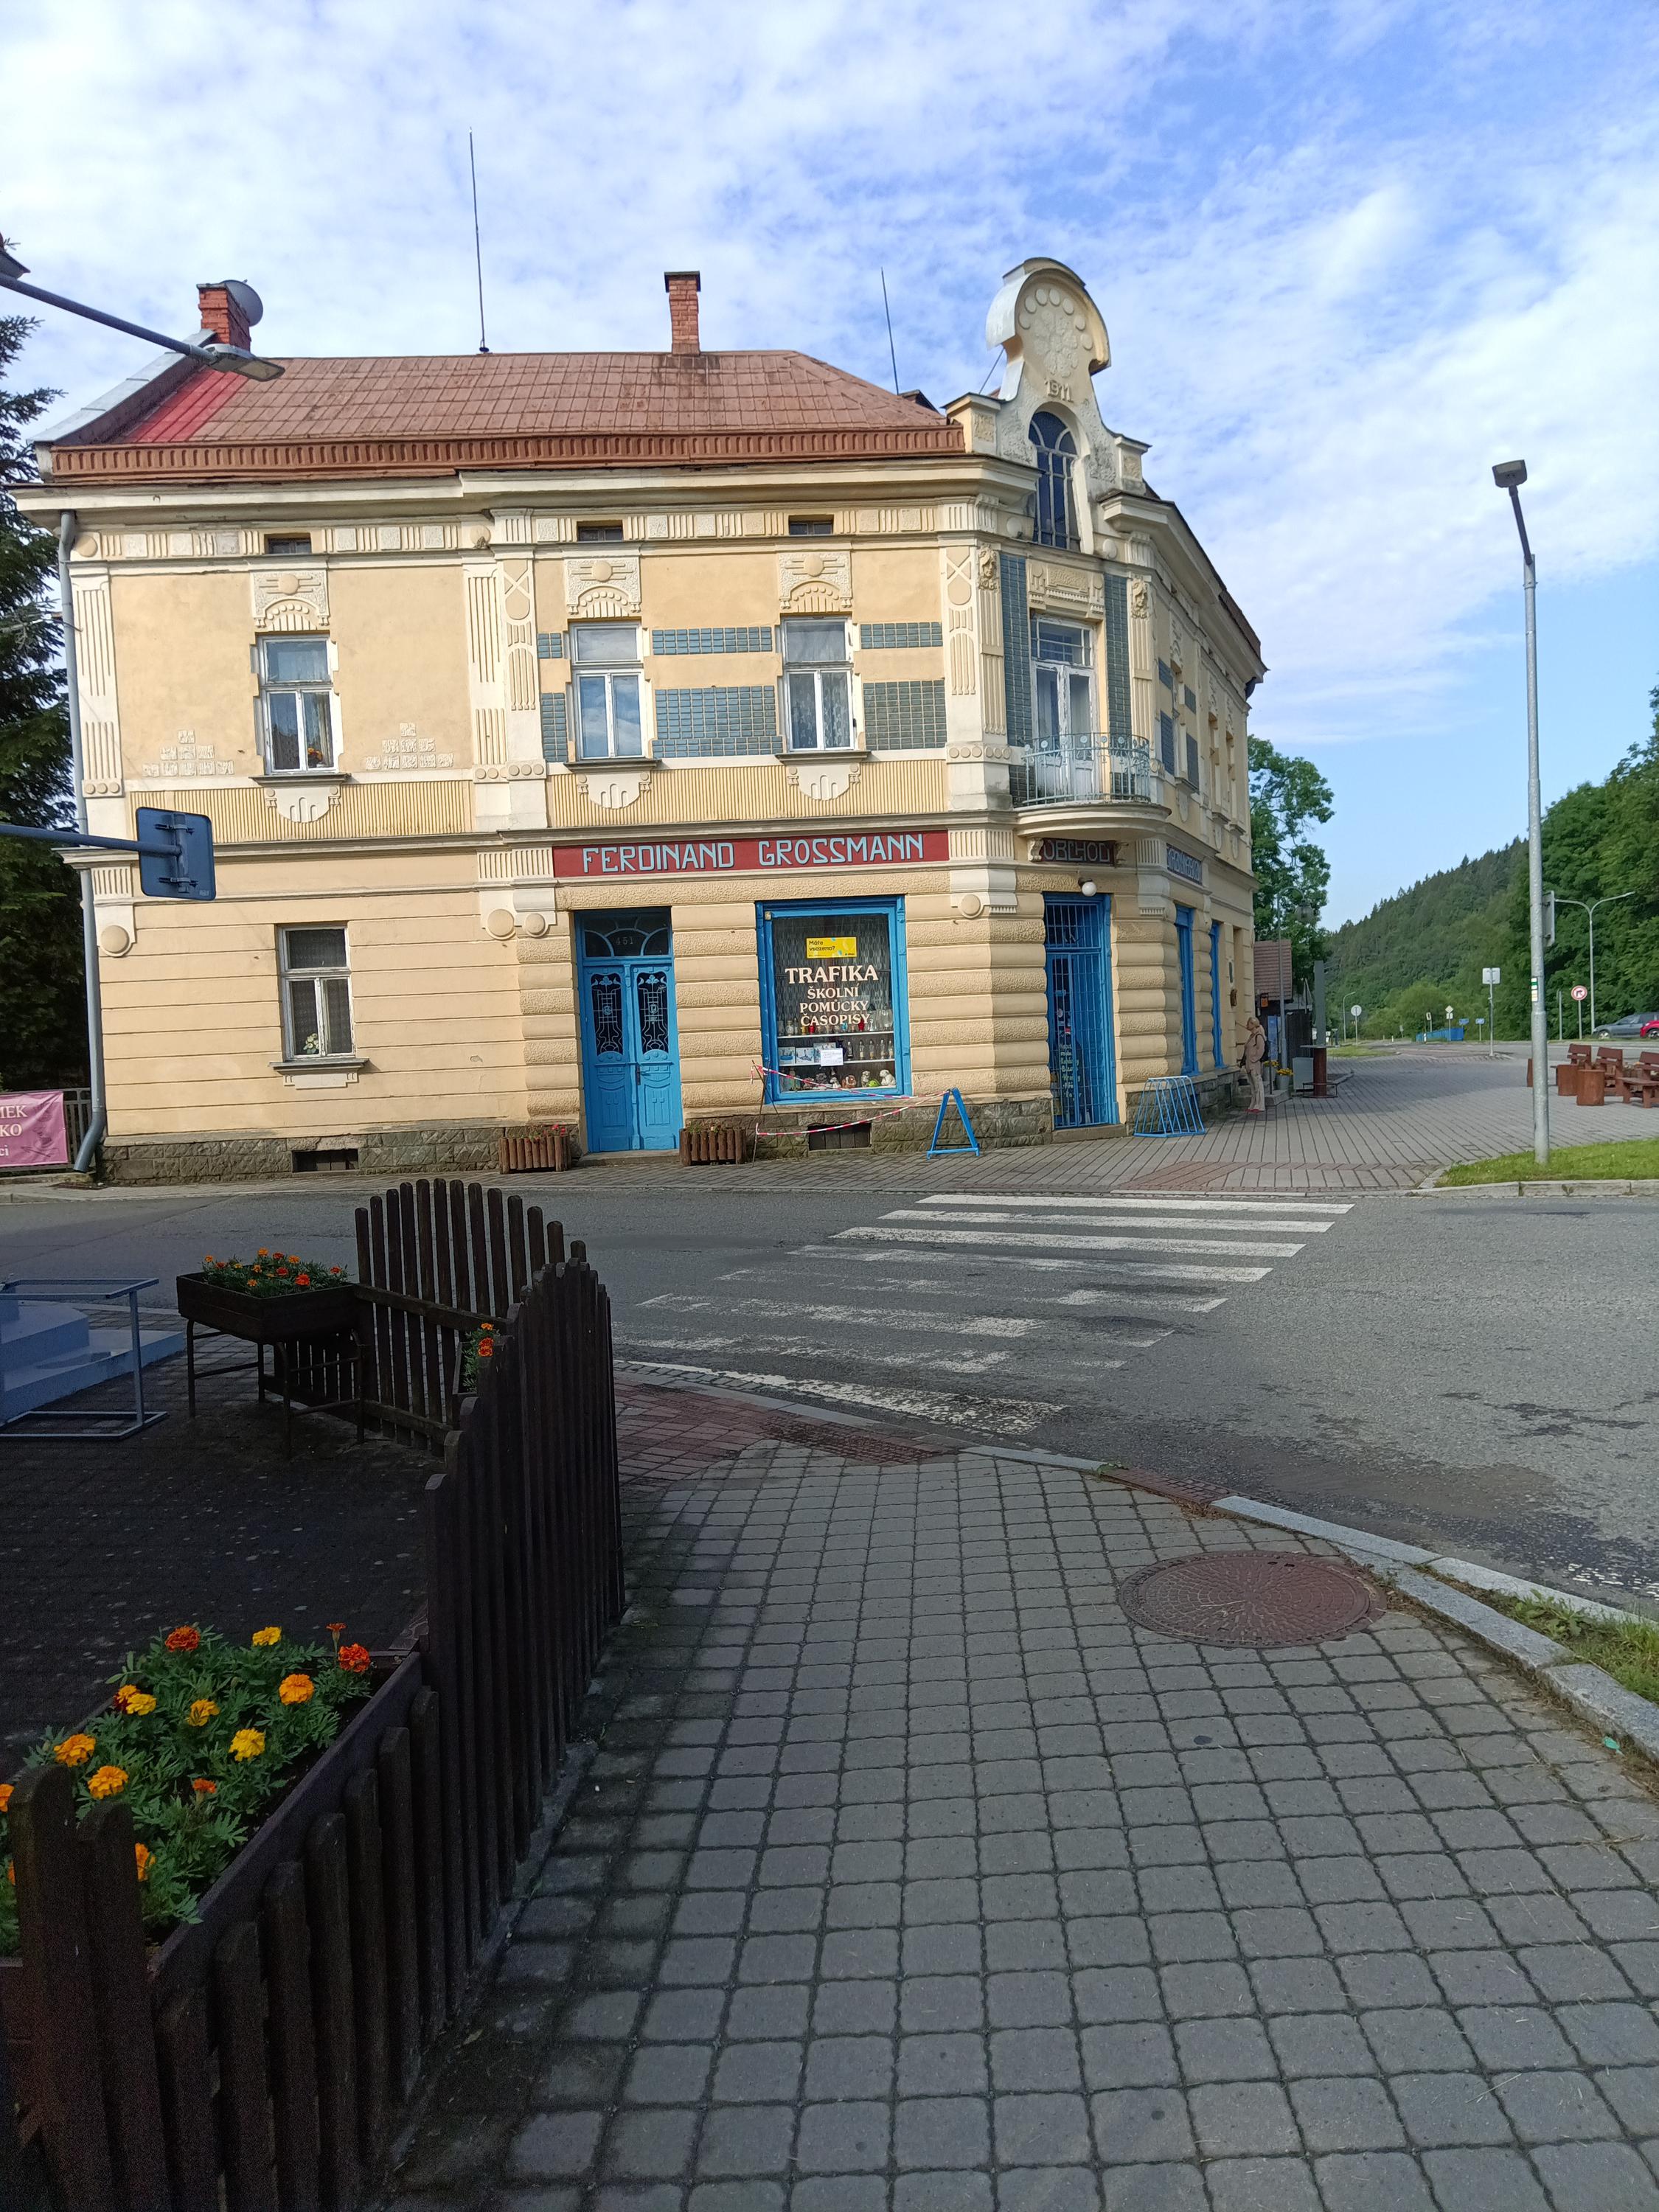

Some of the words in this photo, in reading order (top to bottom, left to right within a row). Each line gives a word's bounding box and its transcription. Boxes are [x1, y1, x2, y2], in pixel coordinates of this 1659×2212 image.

[1044, 378, 1074, 403] 1911
[582, 842, 735, 874] FERDINAND
[759, 833, 925, 867] GROSSMANN
[1043, 839, 1110, 863] OBCHOD
[785, 964, 879, 984] TRAFIKA
[807, 982, 860, 999] ŠKOLNÍ
[799, 998, 869, 1013] POMŮCKY
[800, 1012, 871, 1026] ČASOPISY
